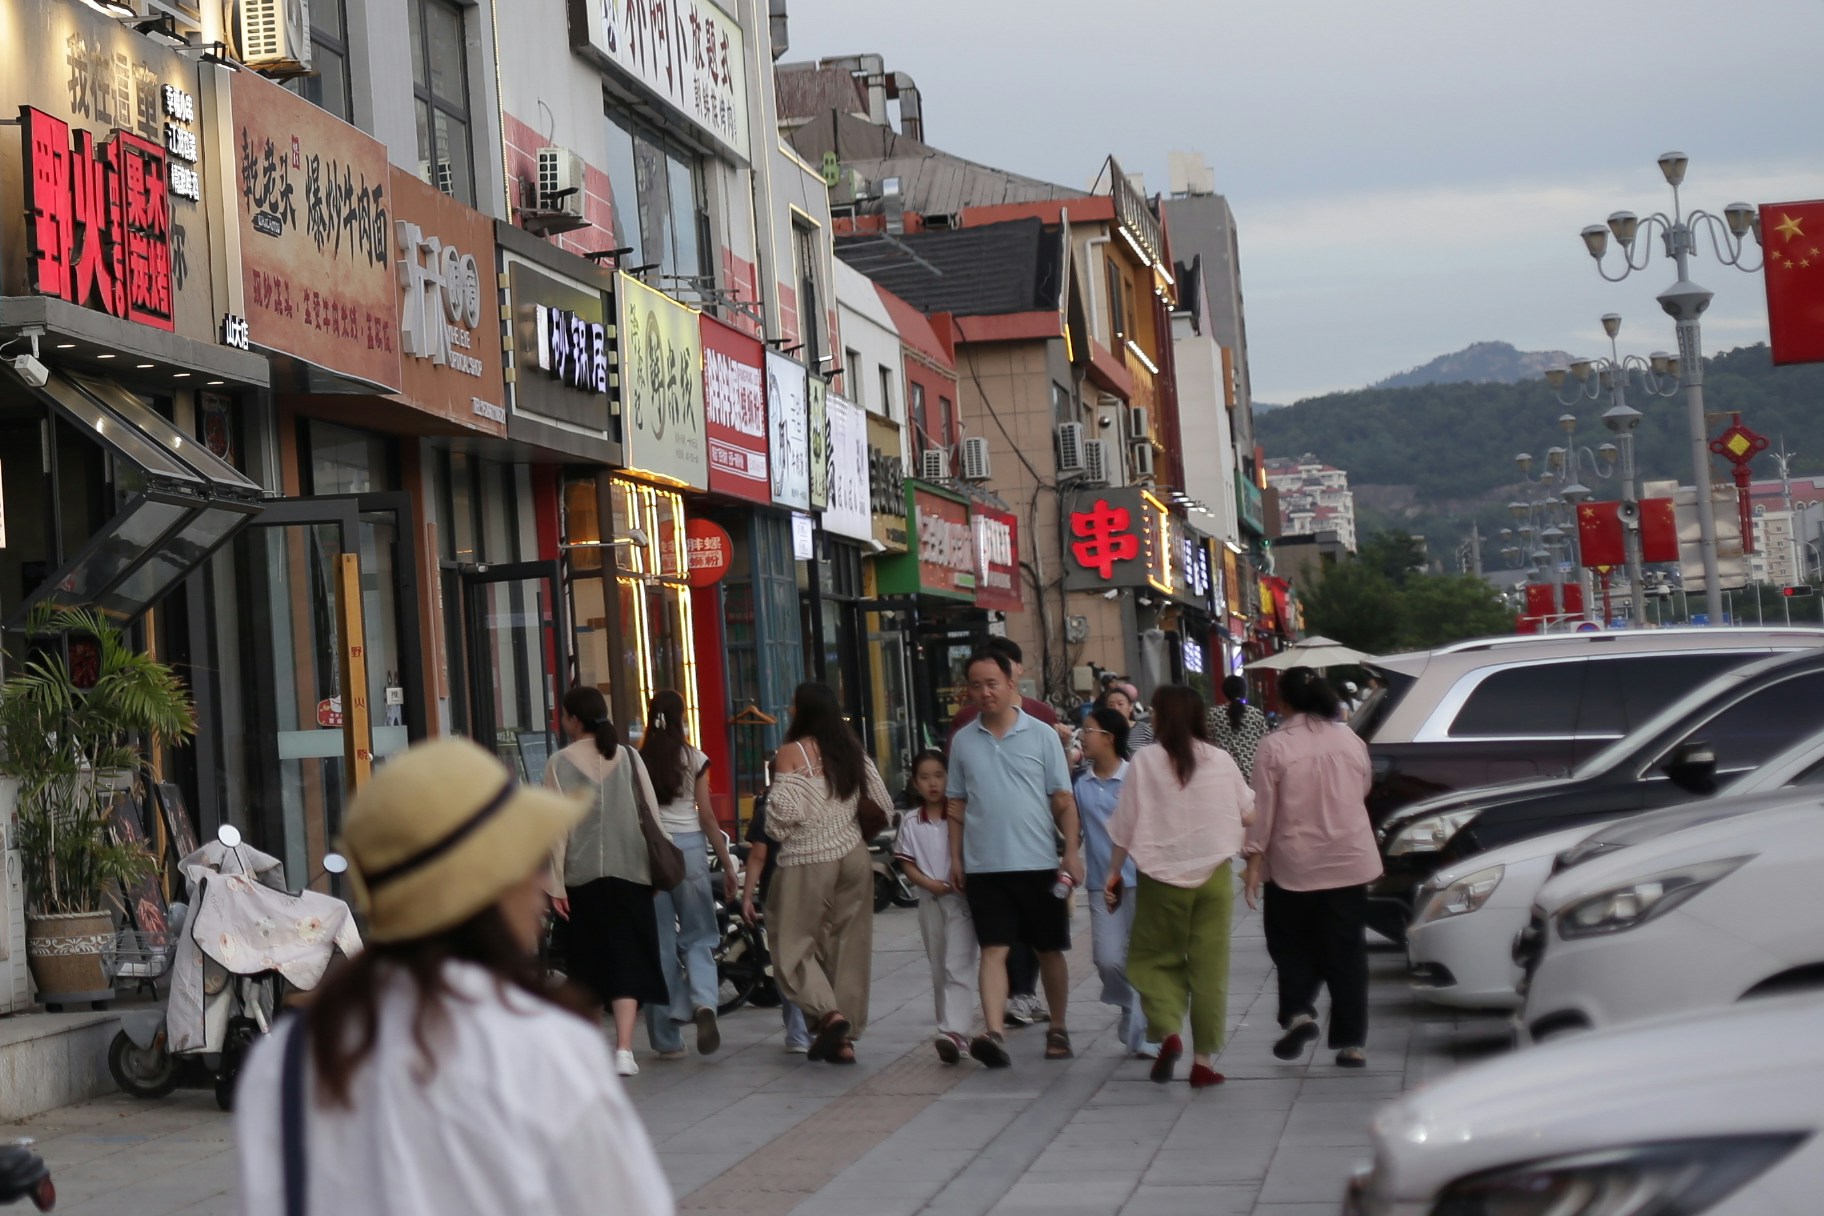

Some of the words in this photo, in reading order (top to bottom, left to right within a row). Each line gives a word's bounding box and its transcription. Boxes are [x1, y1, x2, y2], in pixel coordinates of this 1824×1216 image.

[27, 105, 114, 315] 野火
[304, 154, 388, 271] 爆炒牛肉面
[223, 313, 250, 351] 山大店
[1069, 498, 1140, 580] 串
